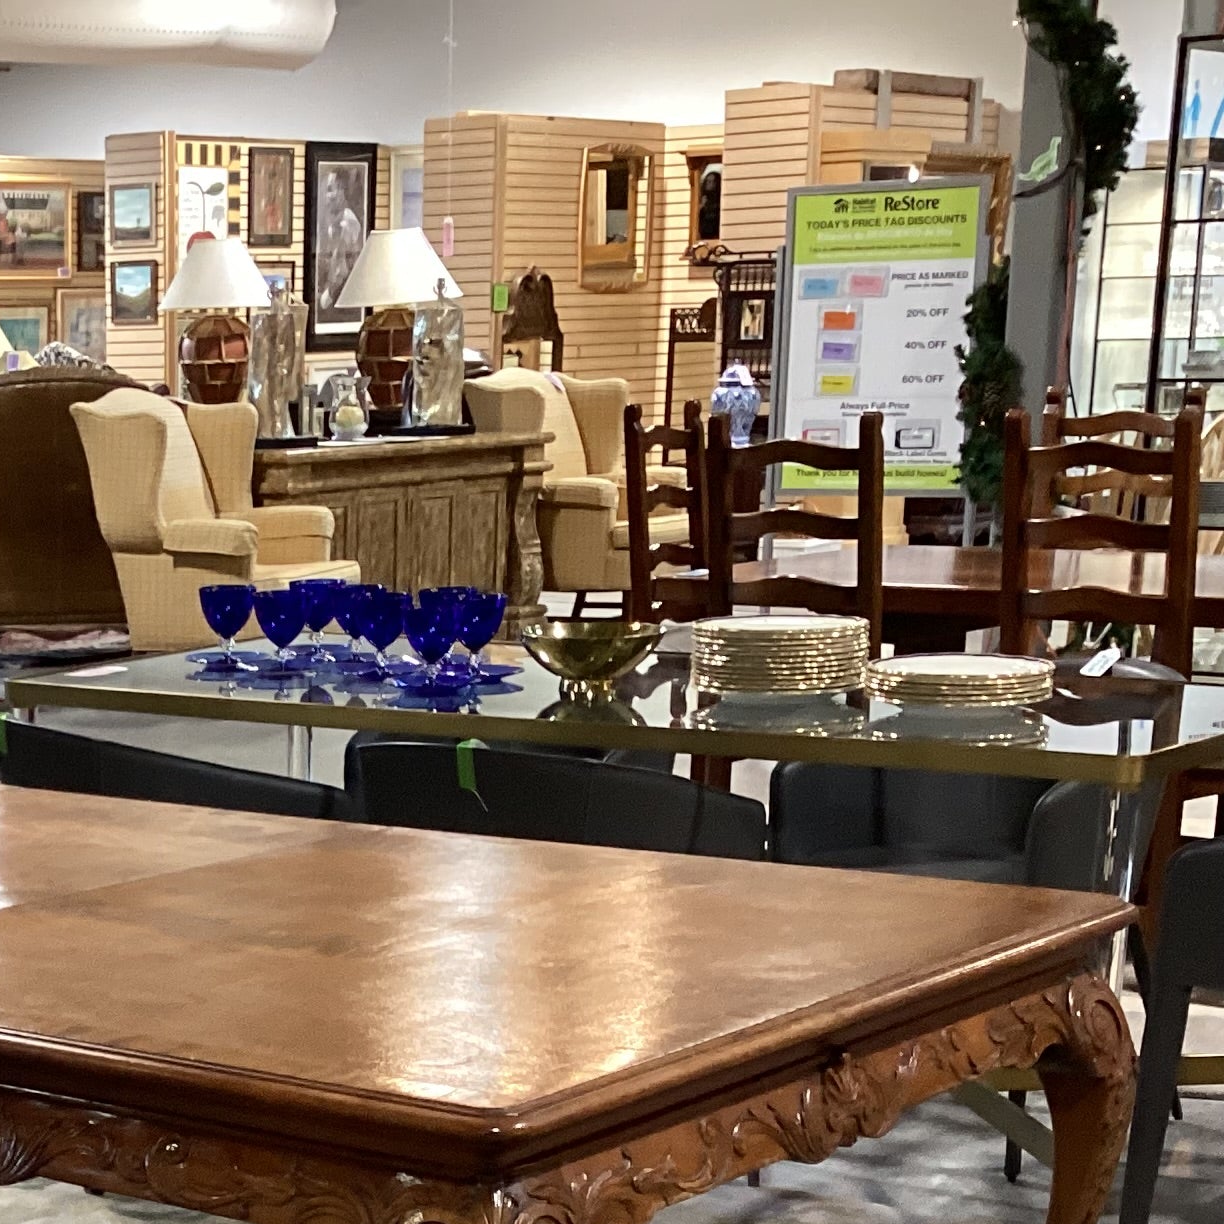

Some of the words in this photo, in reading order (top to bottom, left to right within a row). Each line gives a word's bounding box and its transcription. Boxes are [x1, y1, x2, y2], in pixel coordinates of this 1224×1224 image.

[884, 195, 940, 211] ReStore
[807, 219, 849, 229] TODAY'S
[852, 218, 881, 227] PRICE
[885, 216, 905, 226] TAG
[907, 214, 967, 225] DISCOUNTS
[891, 272, 916, 280] PRICE
[918, 272, 930, 280] AS
[932, 270, 969, 279] MARKED
[906, 309, 927, 318] 20%
[929, 308, 949, 317] OFF
[904, 341, 925, 349] 40%
[927, 340, 947, 349] OFF
[902, 375, 923, 384] 60%
[925, 374, 944, 383] OFF
[840, 402, 869, 410] Always
